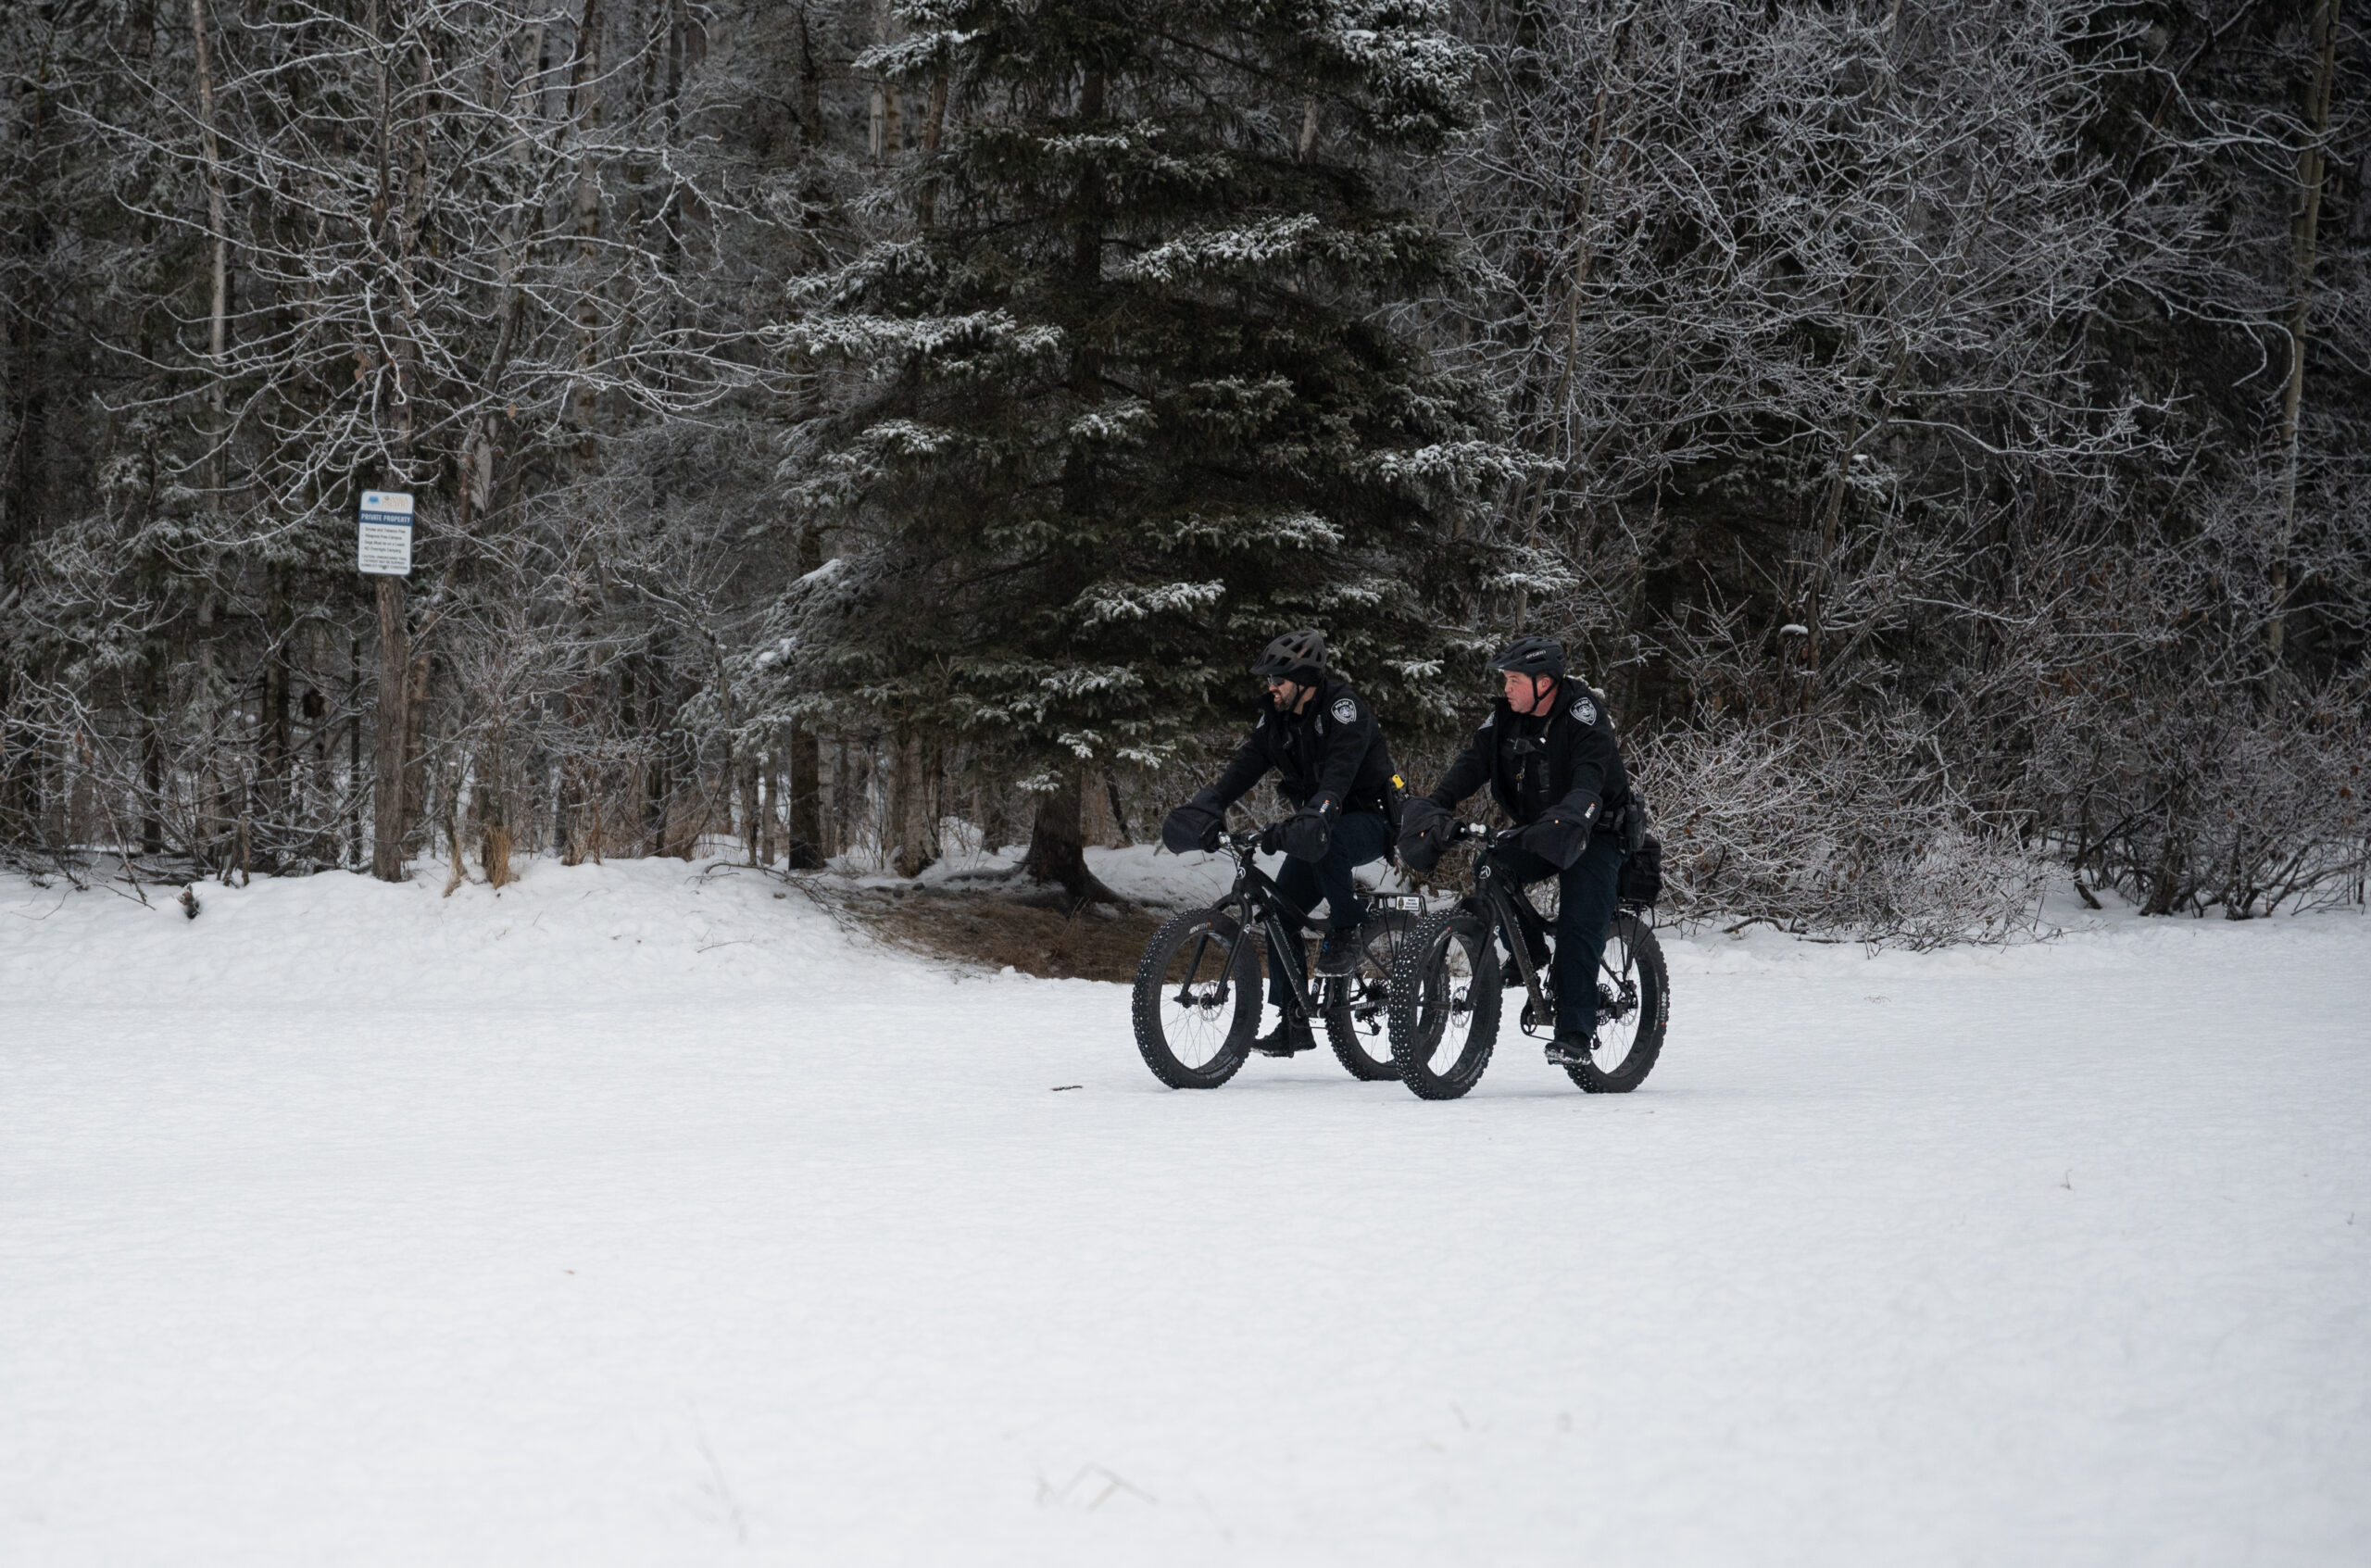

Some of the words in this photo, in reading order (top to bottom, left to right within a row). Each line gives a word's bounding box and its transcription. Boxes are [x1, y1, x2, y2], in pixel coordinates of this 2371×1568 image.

[361, 513, 383, 521] PRIVATE
[383, 515, 410, 523] PROPERTY
[1574, 700, 1588, 709] POLICE
